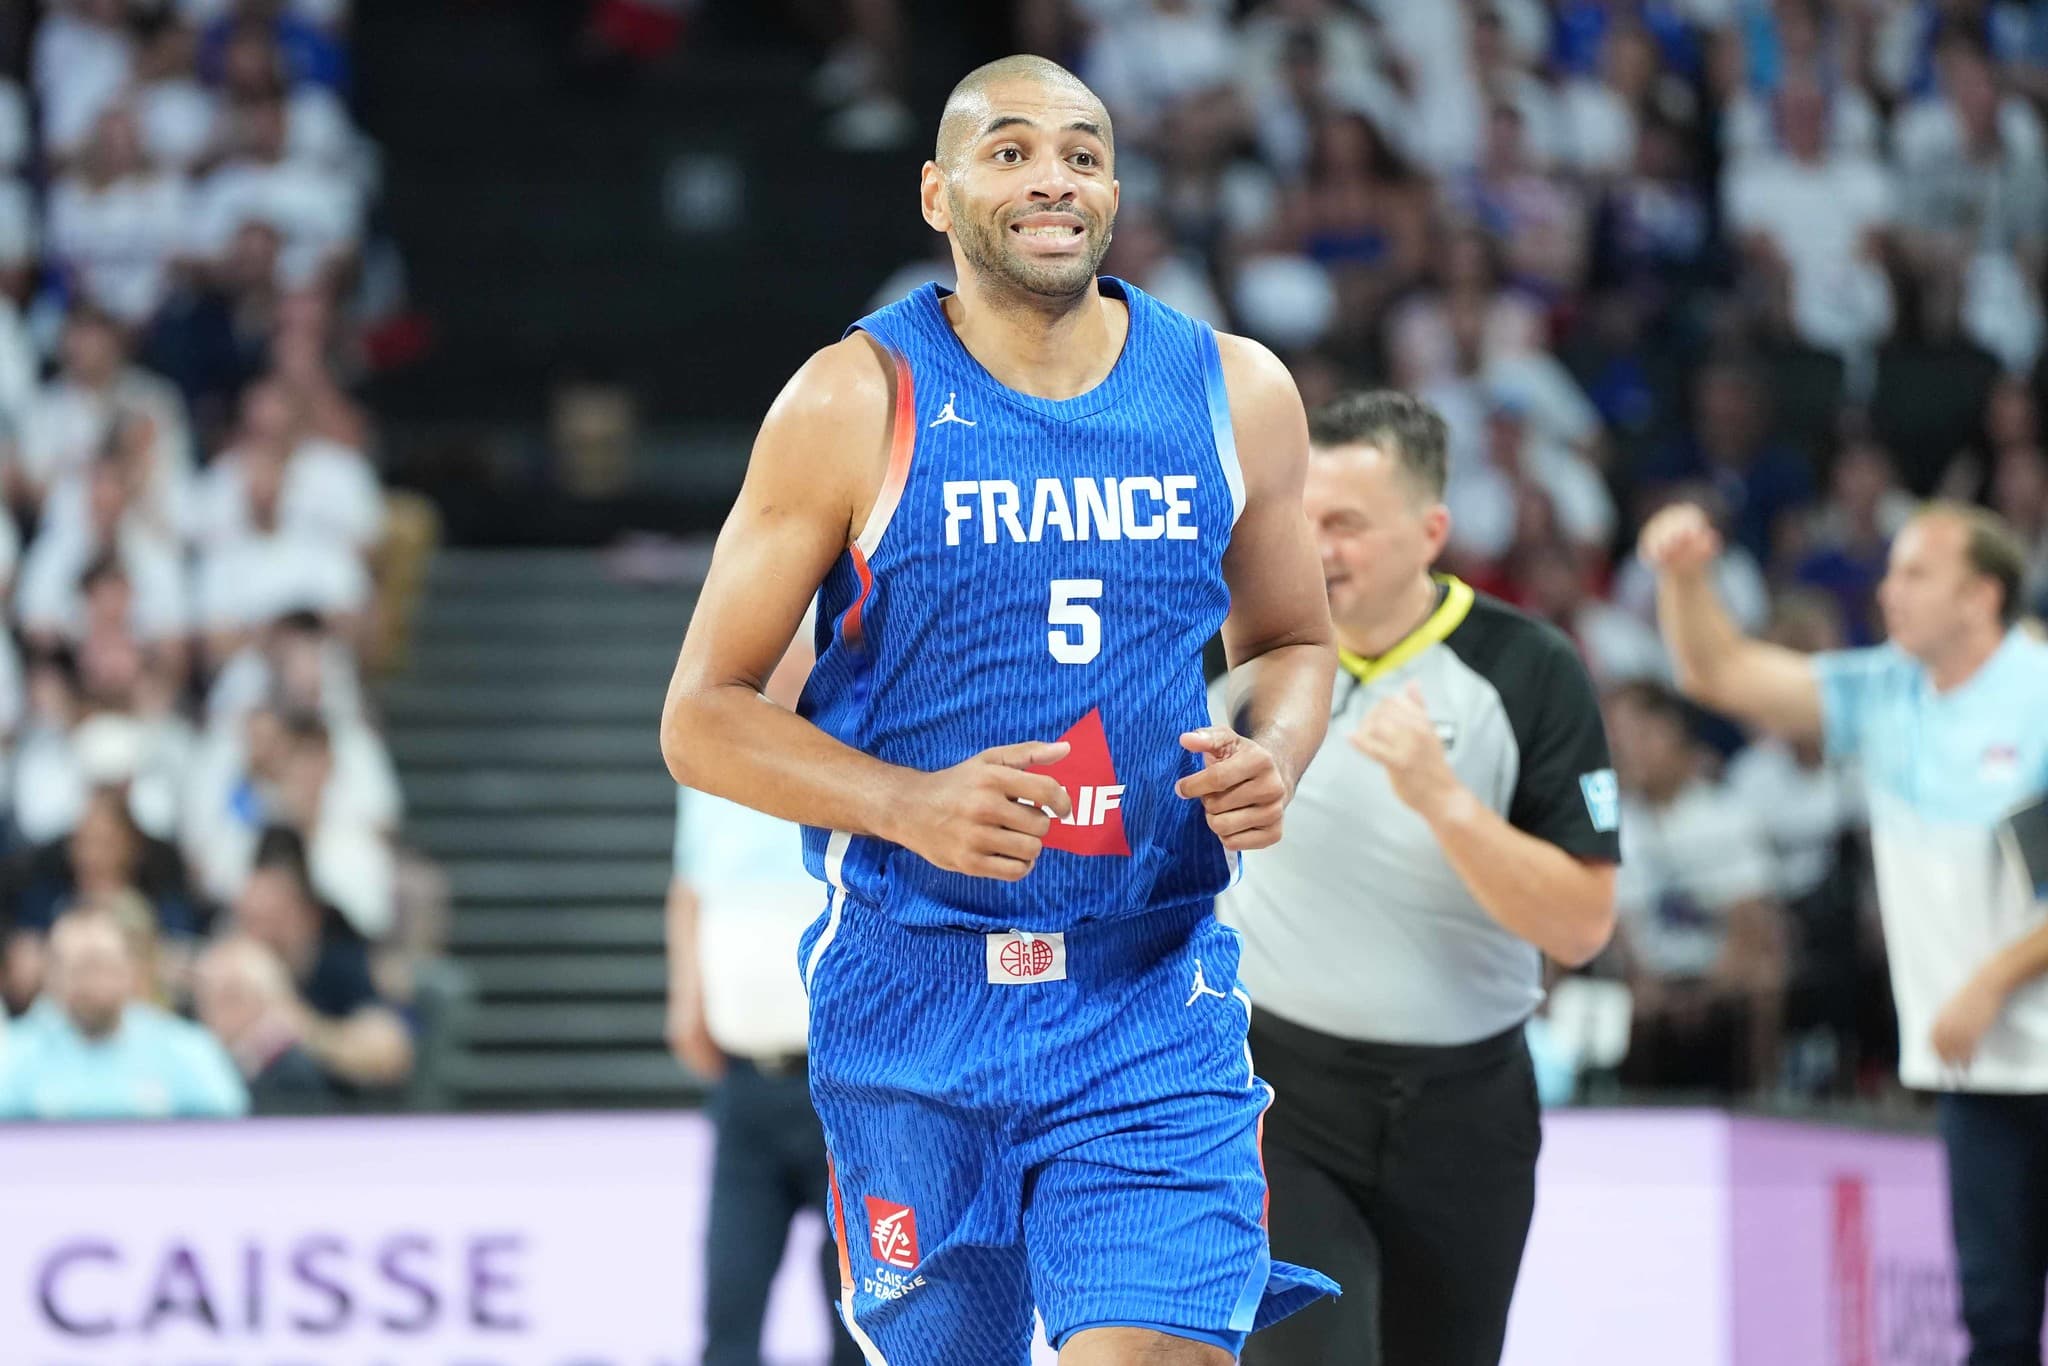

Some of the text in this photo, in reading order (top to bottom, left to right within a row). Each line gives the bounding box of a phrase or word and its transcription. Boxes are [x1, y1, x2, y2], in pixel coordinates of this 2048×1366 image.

[943, 475, 1198, 546] FRANCE
[1047, 579, 1103, 665] 5
[34, 1232, 533, 1338] CAISSE
